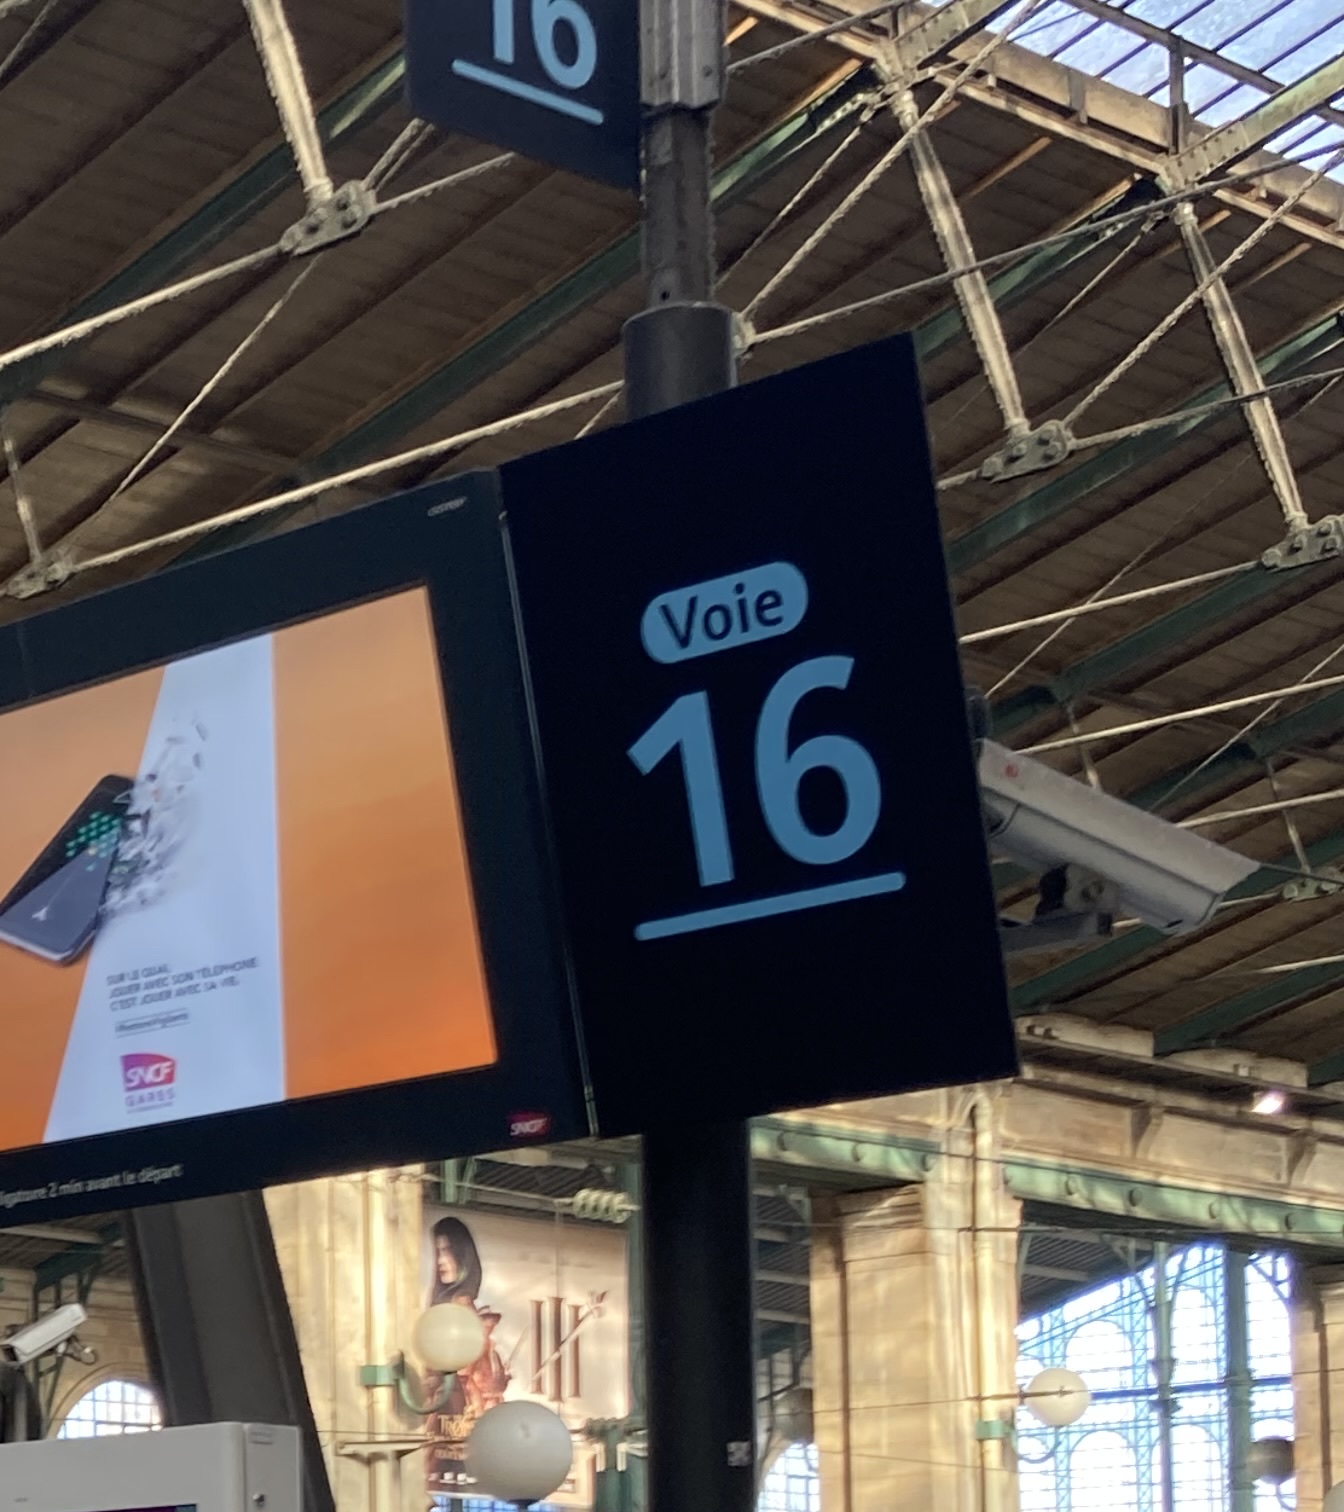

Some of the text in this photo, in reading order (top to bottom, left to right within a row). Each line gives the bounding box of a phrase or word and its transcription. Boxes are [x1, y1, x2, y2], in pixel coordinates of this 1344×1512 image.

[658, 582, 785, 650] Voie
[625, 654, 882, 888] 16
[124, 1060, 174, 1089] SNCF
